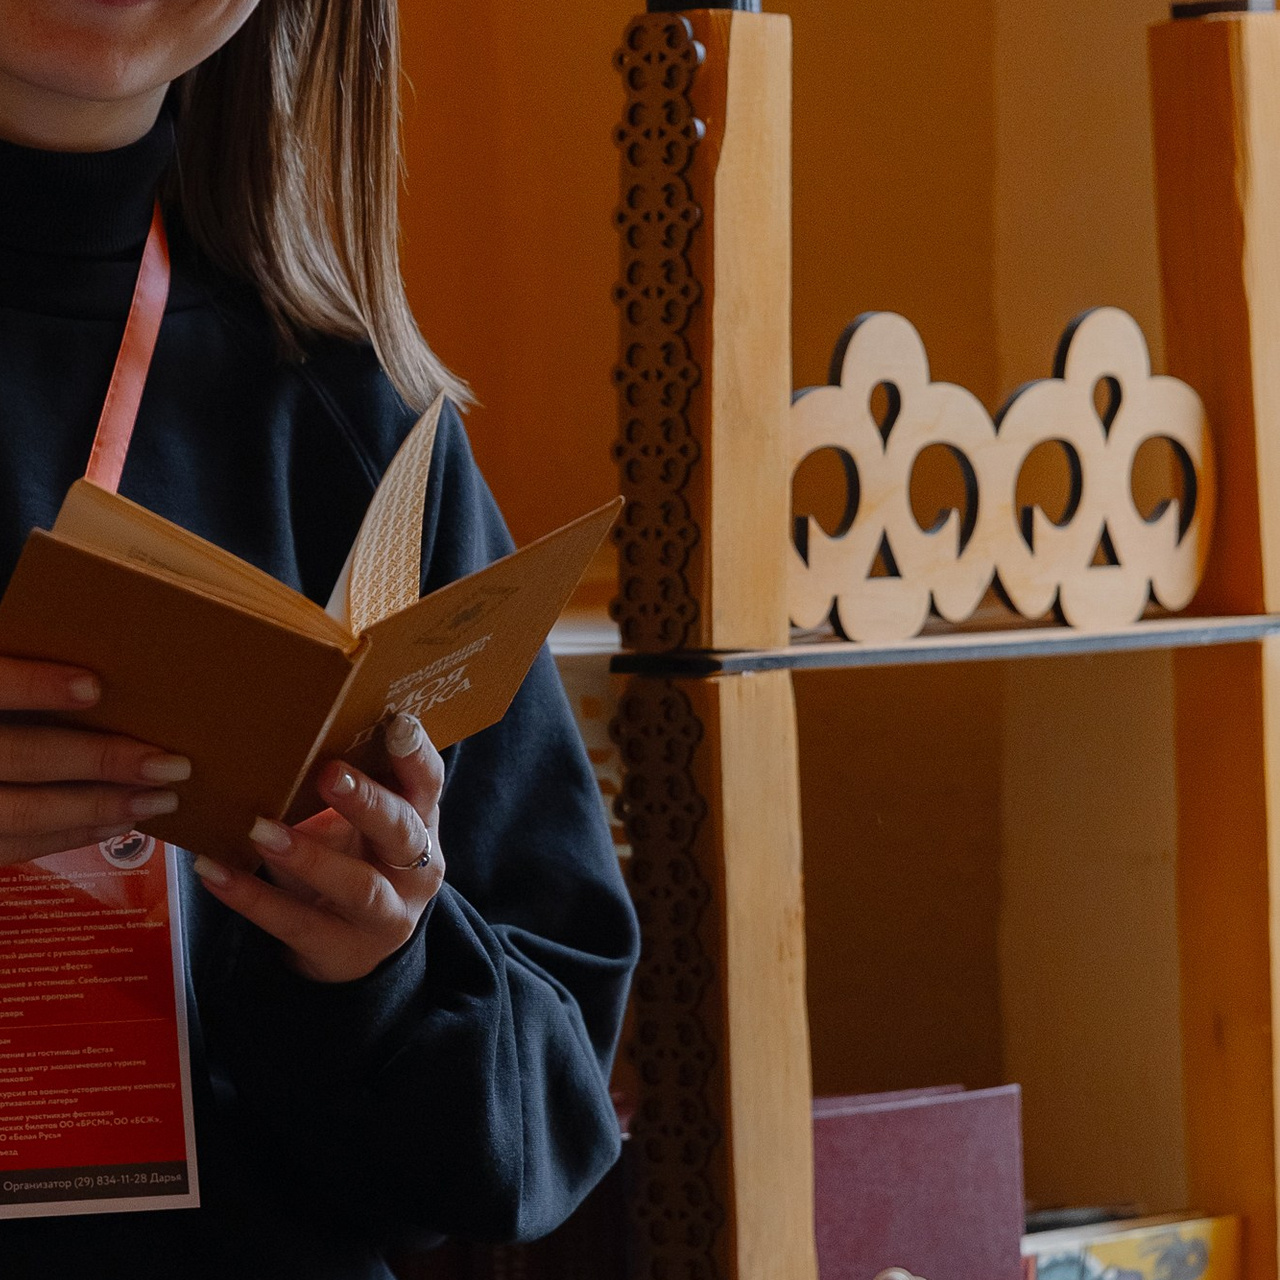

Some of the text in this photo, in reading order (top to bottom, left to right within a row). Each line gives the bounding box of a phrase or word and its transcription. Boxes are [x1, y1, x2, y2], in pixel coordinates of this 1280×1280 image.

[347, 677, 473, 751] ДДКА
[376, 664, 469, 722] МОЯ
[3, 1172, 182, 1192] Организатор (29) 834-11-28 Дарья
